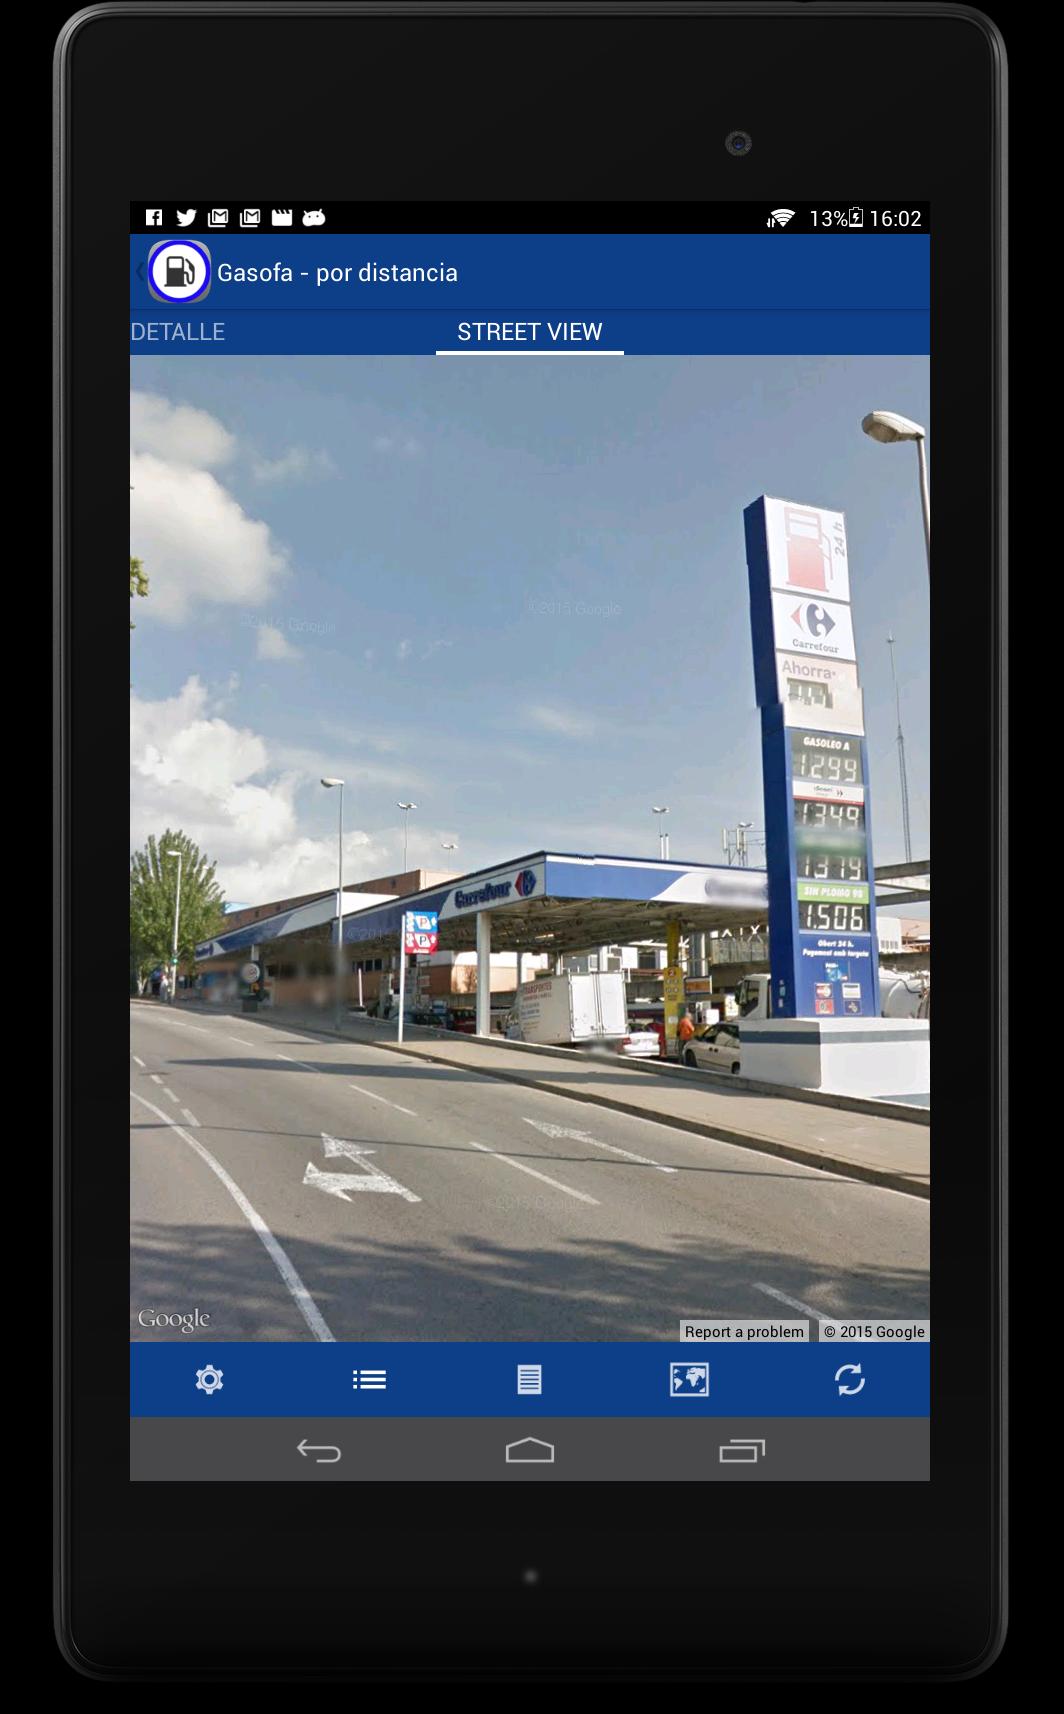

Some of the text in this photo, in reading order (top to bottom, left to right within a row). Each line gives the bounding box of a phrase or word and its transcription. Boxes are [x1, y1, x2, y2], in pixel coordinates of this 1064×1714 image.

[810, 210, 922, 227] 13% 16:02
[217, 262, 293, 283] Gasofa
[316, 266, 353, 286] por
[358, 262, 458, 283] distancia
[131, 322, 225, 341] DETALLE
[457, 322, 603, 341] STREET VIEW
[834, 537, 846, 557] 24
[792, 638, 840, 654] Carrefour
[803, 736, 851, 751] GASOLEO A
[685, 1325, 804, 1341] Report a problem
[823, 1325, 925, 1341] © 2015 Google
